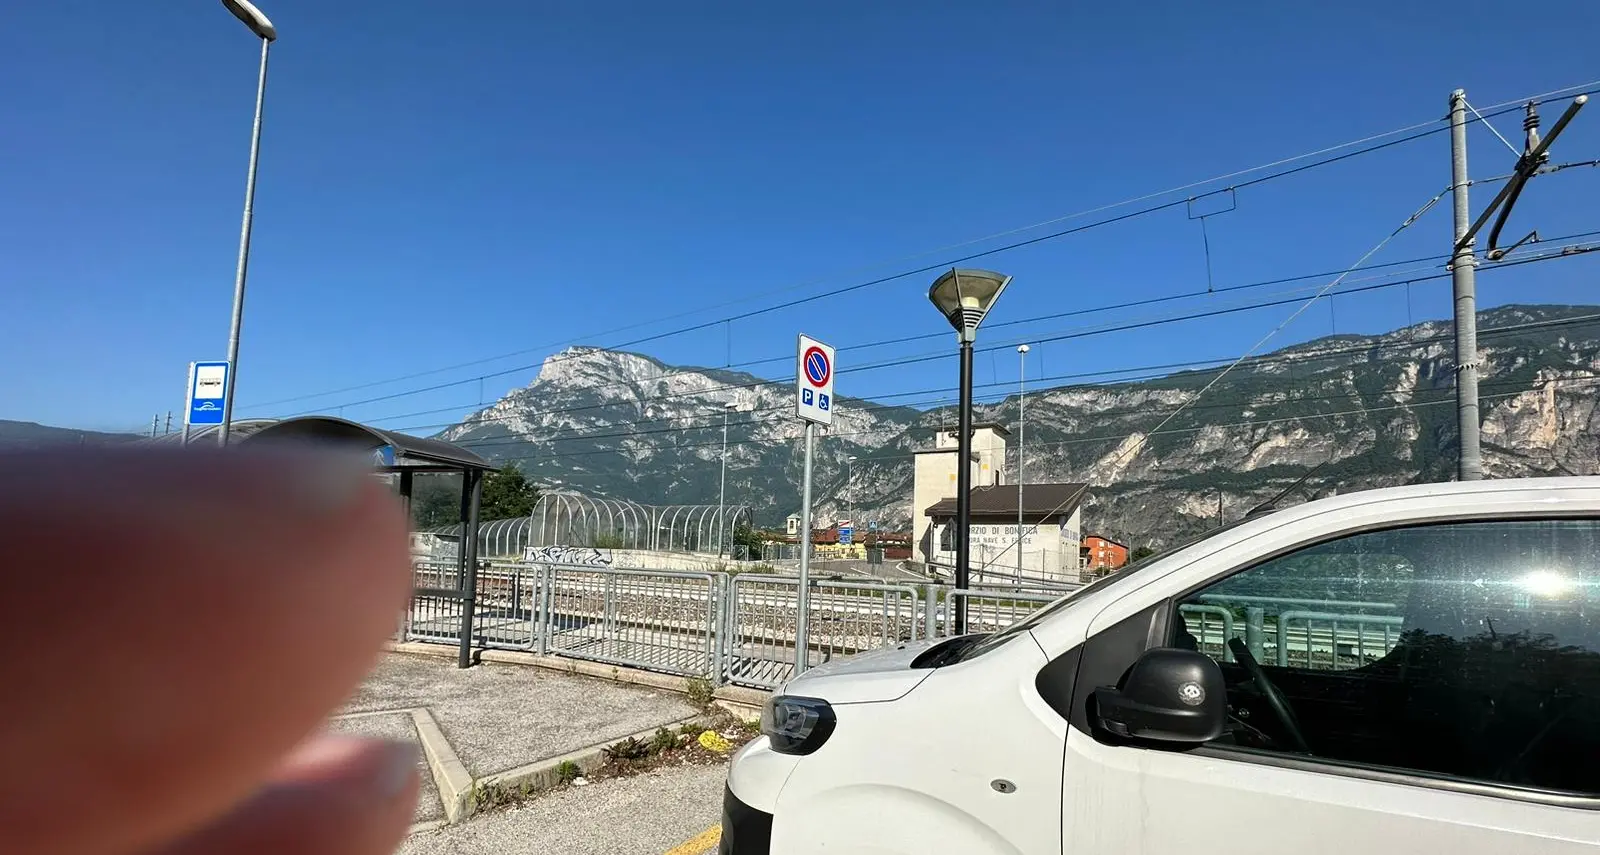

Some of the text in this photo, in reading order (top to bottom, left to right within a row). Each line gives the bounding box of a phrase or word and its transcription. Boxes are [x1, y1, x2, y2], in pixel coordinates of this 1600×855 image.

[804, 390, 812, 402] P
[991, 526, 1000, 535] DI
[1004, 526, 1038, 535] BONFICA
